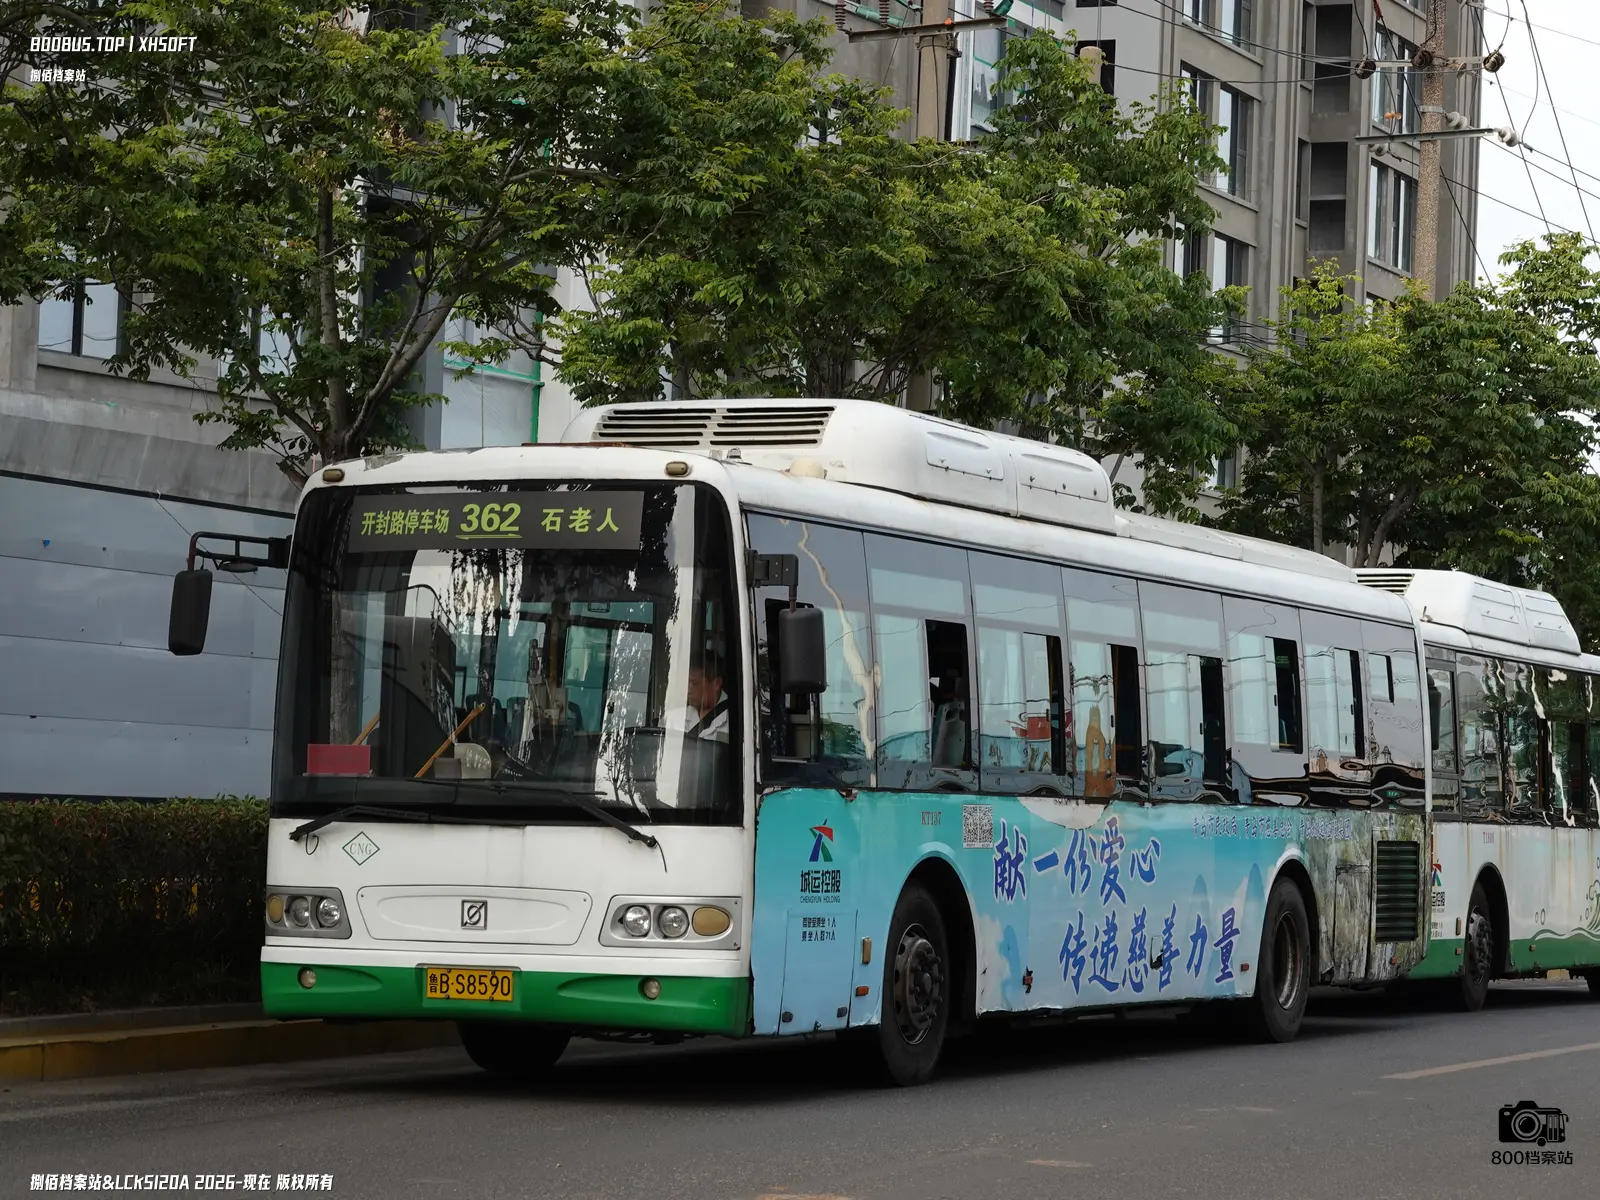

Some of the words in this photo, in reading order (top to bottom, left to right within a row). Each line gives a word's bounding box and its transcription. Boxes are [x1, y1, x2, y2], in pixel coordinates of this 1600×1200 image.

[361, 508, 449, 535] 开封路停车场
[460, 503, 521, 532] 362
[541, 506, 619, 532] 石老人
[350, 842, 371, 855] CNG
[993, 816, 1160, 906] 献一份爱心
[800, 869, 840, 893] 城运控股
[800, 895, 821, 903] CHENGYUN
[823, 895, 840, 903] HOLDING
[1059, 903, 1240, 995] 传递慈善力量
